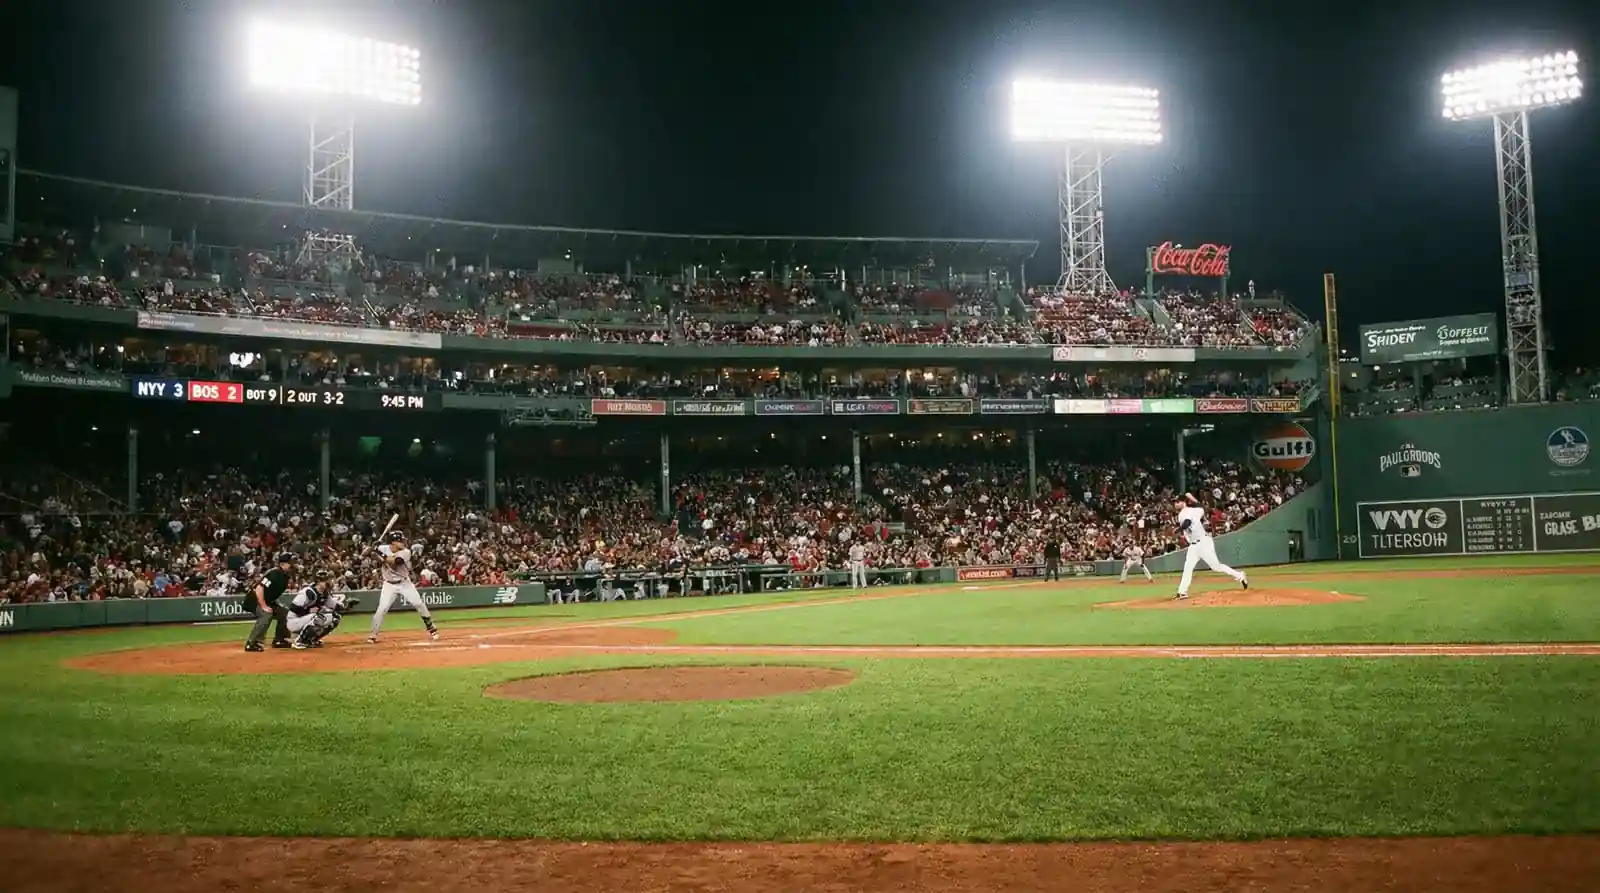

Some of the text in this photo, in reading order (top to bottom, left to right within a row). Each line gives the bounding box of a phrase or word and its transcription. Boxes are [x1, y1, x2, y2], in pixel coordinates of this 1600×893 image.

[138, 382, 424, 408] NYY 3 BOS 2 BOT 9 2 OUT 3-2 9:45 PM
